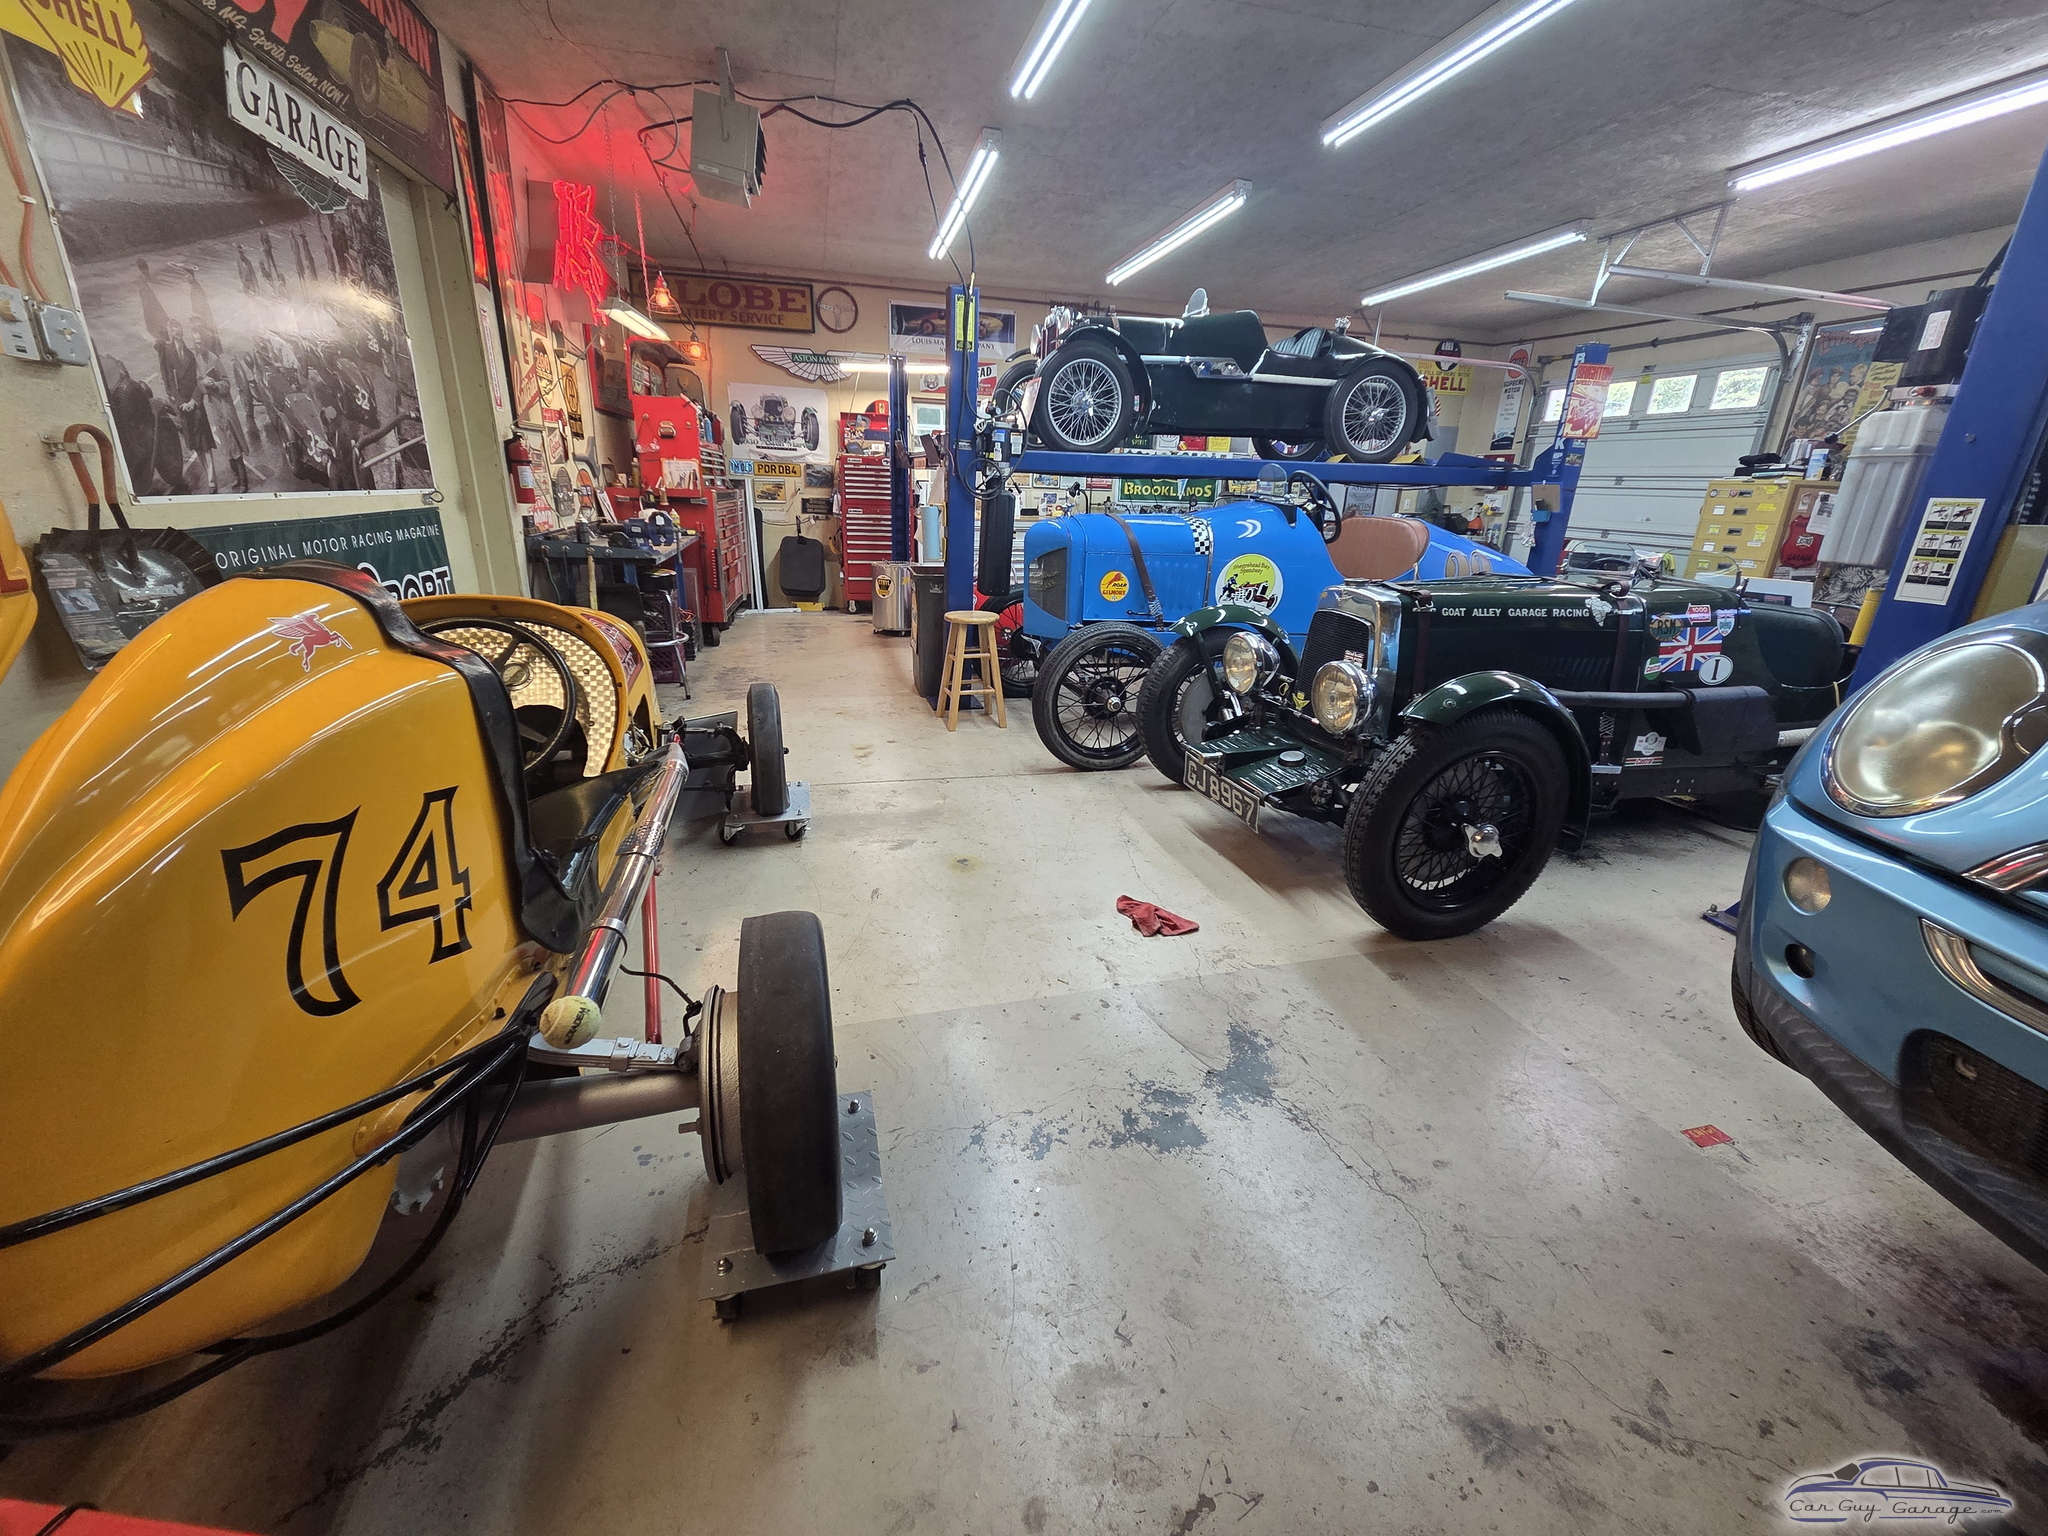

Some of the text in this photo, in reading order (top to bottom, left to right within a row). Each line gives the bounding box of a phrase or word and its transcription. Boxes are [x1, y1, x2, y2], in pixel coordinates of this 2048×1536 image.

[249, 28, 284, 61] Sports
[286, 55, 318, 87] Sedan
[236, 62, 362, 184] GARAGE
[655, 279, 807, 314] LOBE
[690, 308, 785, 325] TERY SERVICE
[912, 337, 946, 346] LOUIS MA
[793, 354, 818, 363] ASTON
[1423, 375, 1466, 391] SHELL
[778, 465, 797, 475] DB4
[215, 524, 440, 570] ORIGINAL MOTOR RACING MAGAZINE
[1442, 607, 1590, 617] GOAT ALLEY GARAGE RACING
[1657, 618, 1677, 636] RSM
[1187, 760, 1255, 825] GJ 8967
[220, 785, 474, 1018] 74
